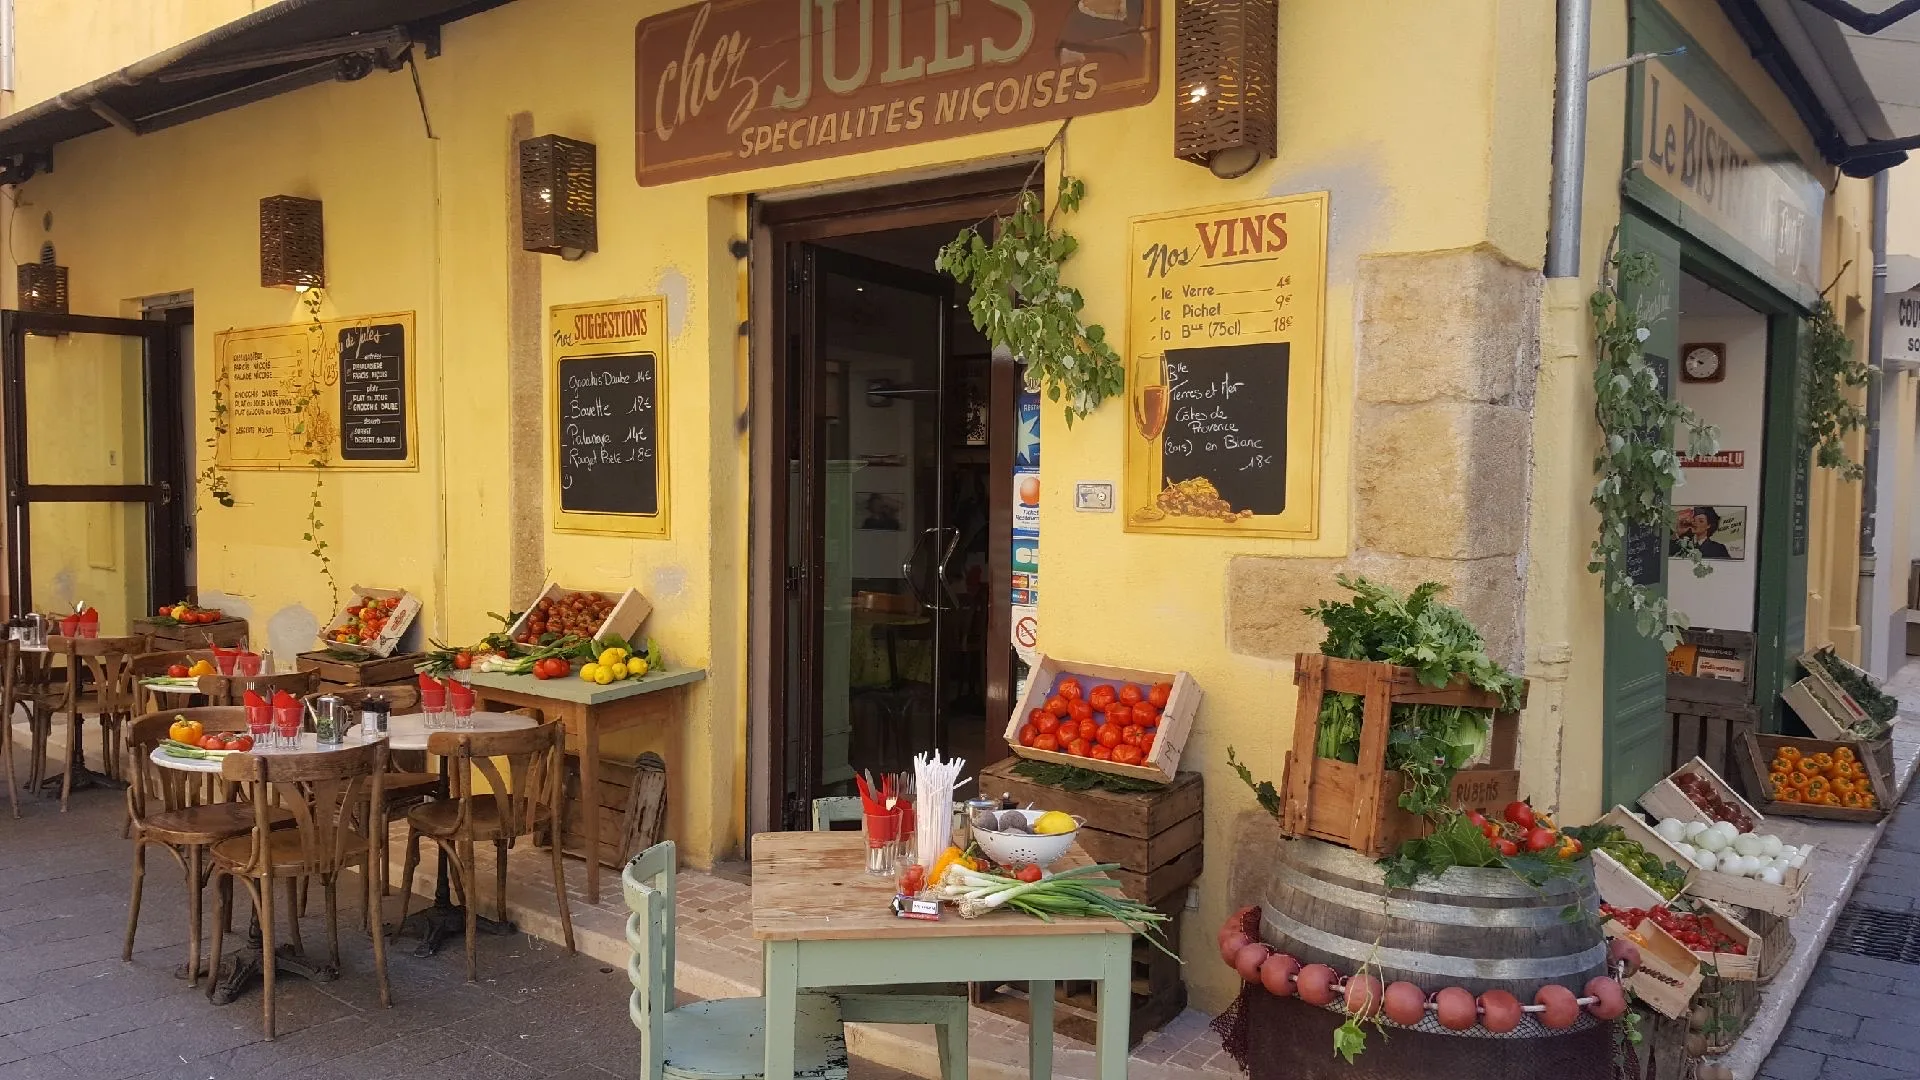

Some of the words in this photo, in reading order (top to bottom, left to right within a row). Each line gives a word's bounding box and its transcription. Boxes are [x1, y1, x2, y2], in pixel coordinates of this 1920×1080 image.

[770, 0, 1035, 109] JULES
[935, 62, 1099, 122] NIÇOISES
[1648, 73, 1677, 176] Le
[1142, 243, 1192, 279] Nos
[1195, 212, 1288, 259] VINS
[1161, 287, 1172, 300] le
[1182, 284, 1215, 298] Verre
[574, 308, 648, 341] SUGGESTIONS
[1160, 307, 1171, 321] le
[1182, 303, 1221, 318] Pichet
[1208, 319, 1241, 338] (75cl)
[1273, 316, 1293, 332] 18€
[1899, 298, 1920, 328] COU
[1205, 382, 1218, 398] et
[1223, 435, 1264, 450] Blanc
